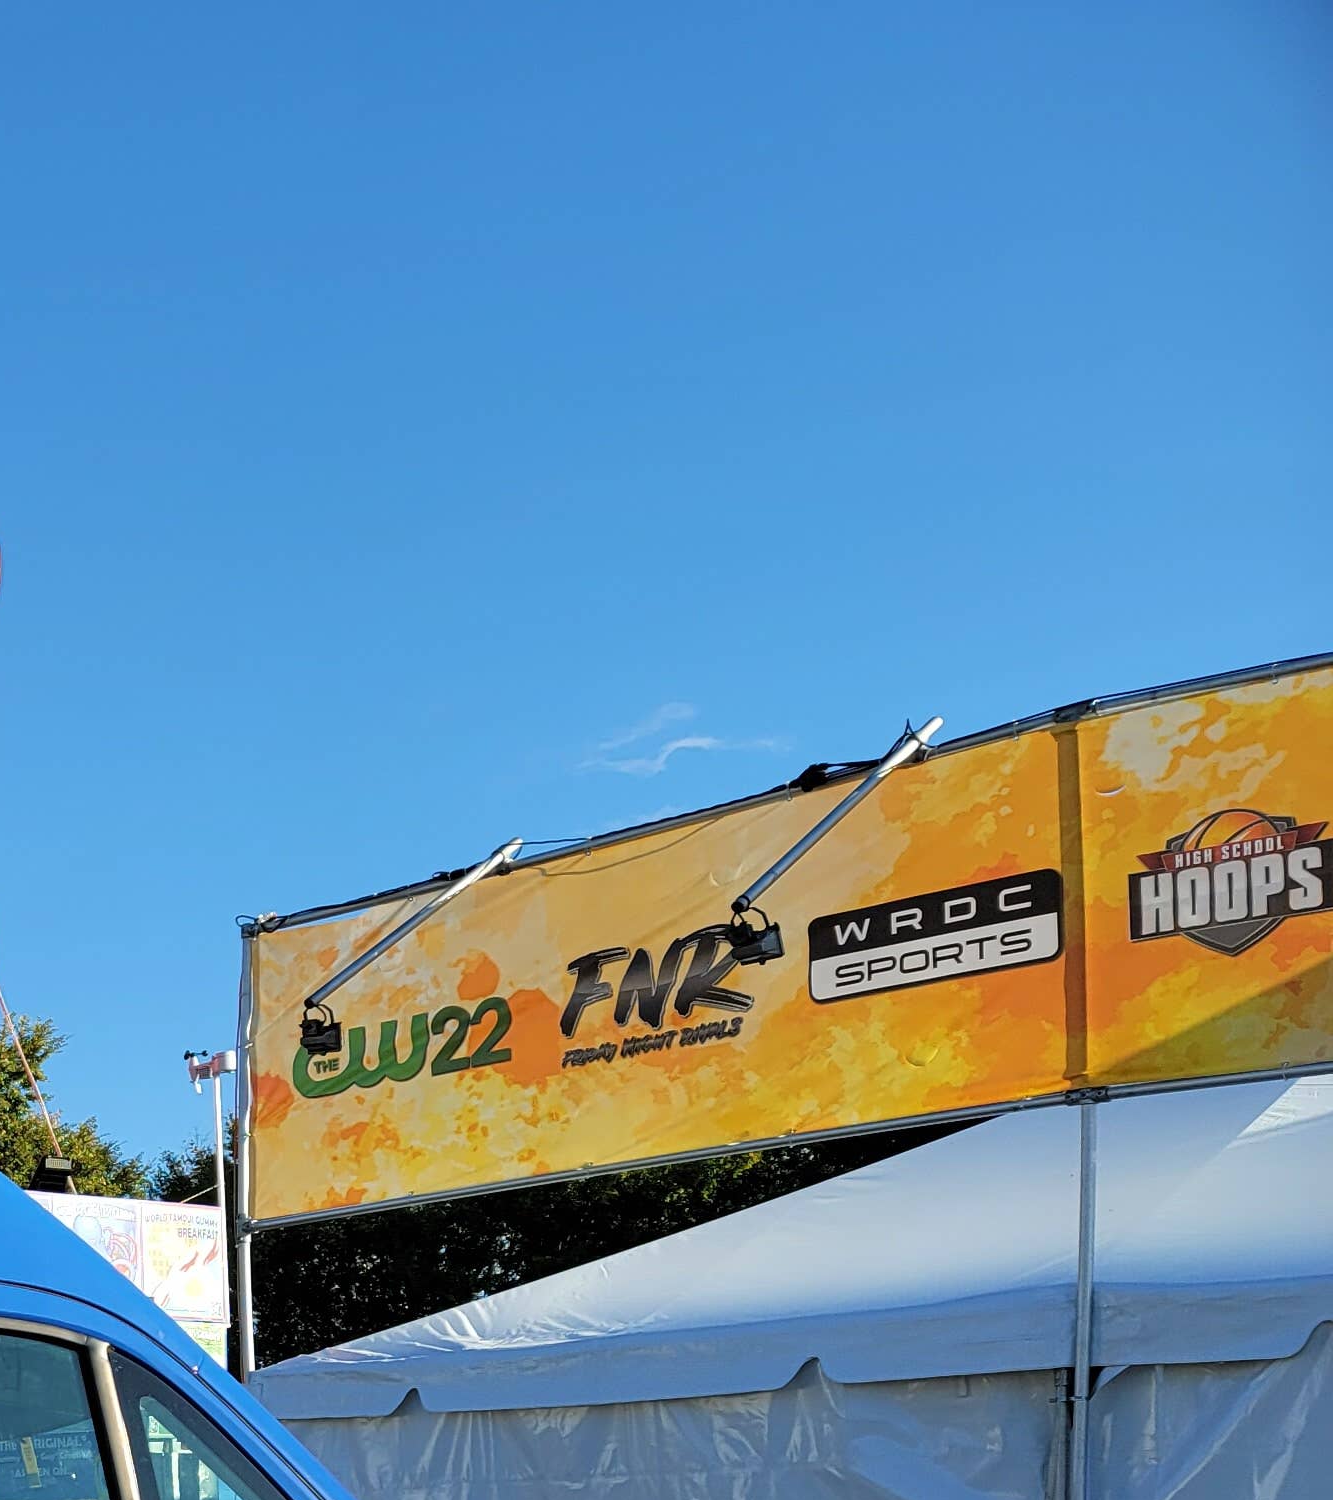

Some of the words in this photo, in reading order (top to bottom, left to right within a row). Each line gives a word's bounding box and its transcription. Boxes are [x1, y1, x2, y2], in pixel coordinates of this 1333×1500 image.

[1175, 851, 1213, 869] HIGH
[1221, 835, 1284, 859] SCHOOL
[834, 884, 1032, 946] WRDC
[1140, 846, 1323, 936] HOOPS
[560, 924, 754, 1037] FNR
[834, 929, 1032, 988] SPORTS
[313, 1058, 340, 1074] THE
[562, 1042, 617, 1068] FRIDAY
[621, 1030, 678, 1058] NIGHT
[679, 1017, 743, 1047] RIVALS
[177, 1228, 218, 1240] BREAKFAST
[32, 1434, 82, 1449] RIGINAL
